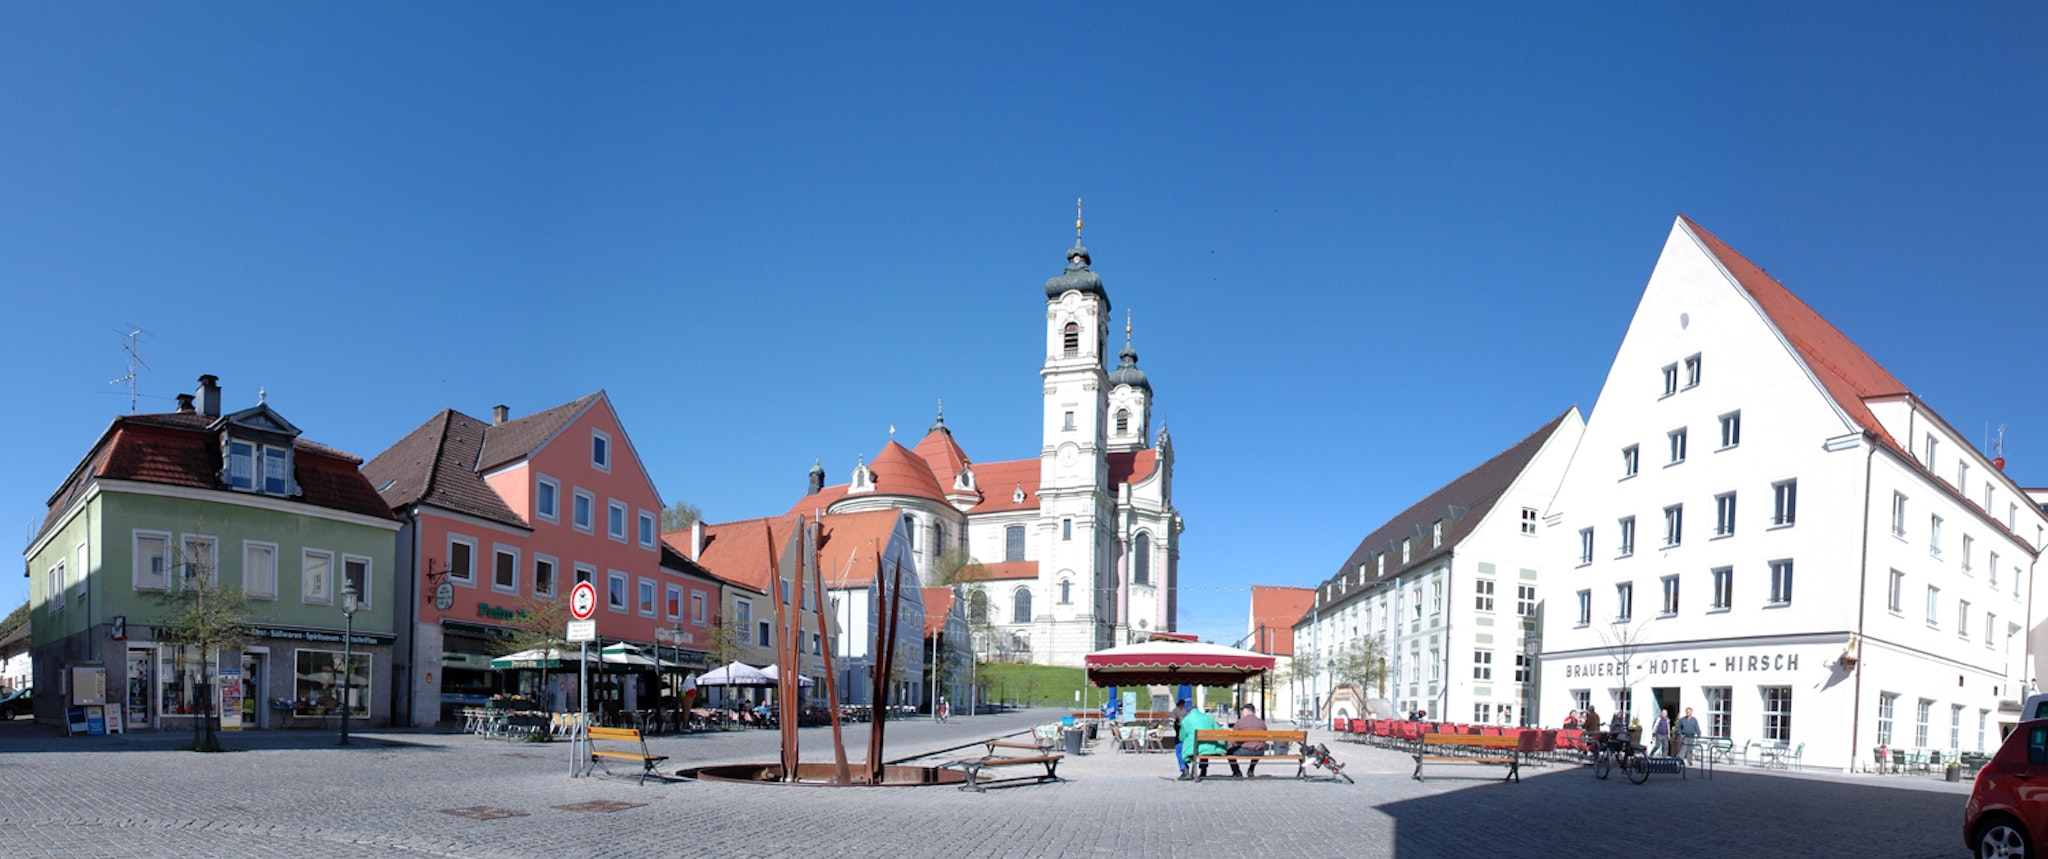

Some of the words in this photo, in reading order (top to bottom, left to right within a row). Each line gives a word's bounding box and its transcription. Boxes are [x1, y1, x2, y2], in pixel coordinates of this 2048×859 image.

[1566, 662, 1630, 678] BRAUEREI
[1649, 658, 1700, 674] HOTEL
[1725, 653, 1799, 672] HIRSCH
